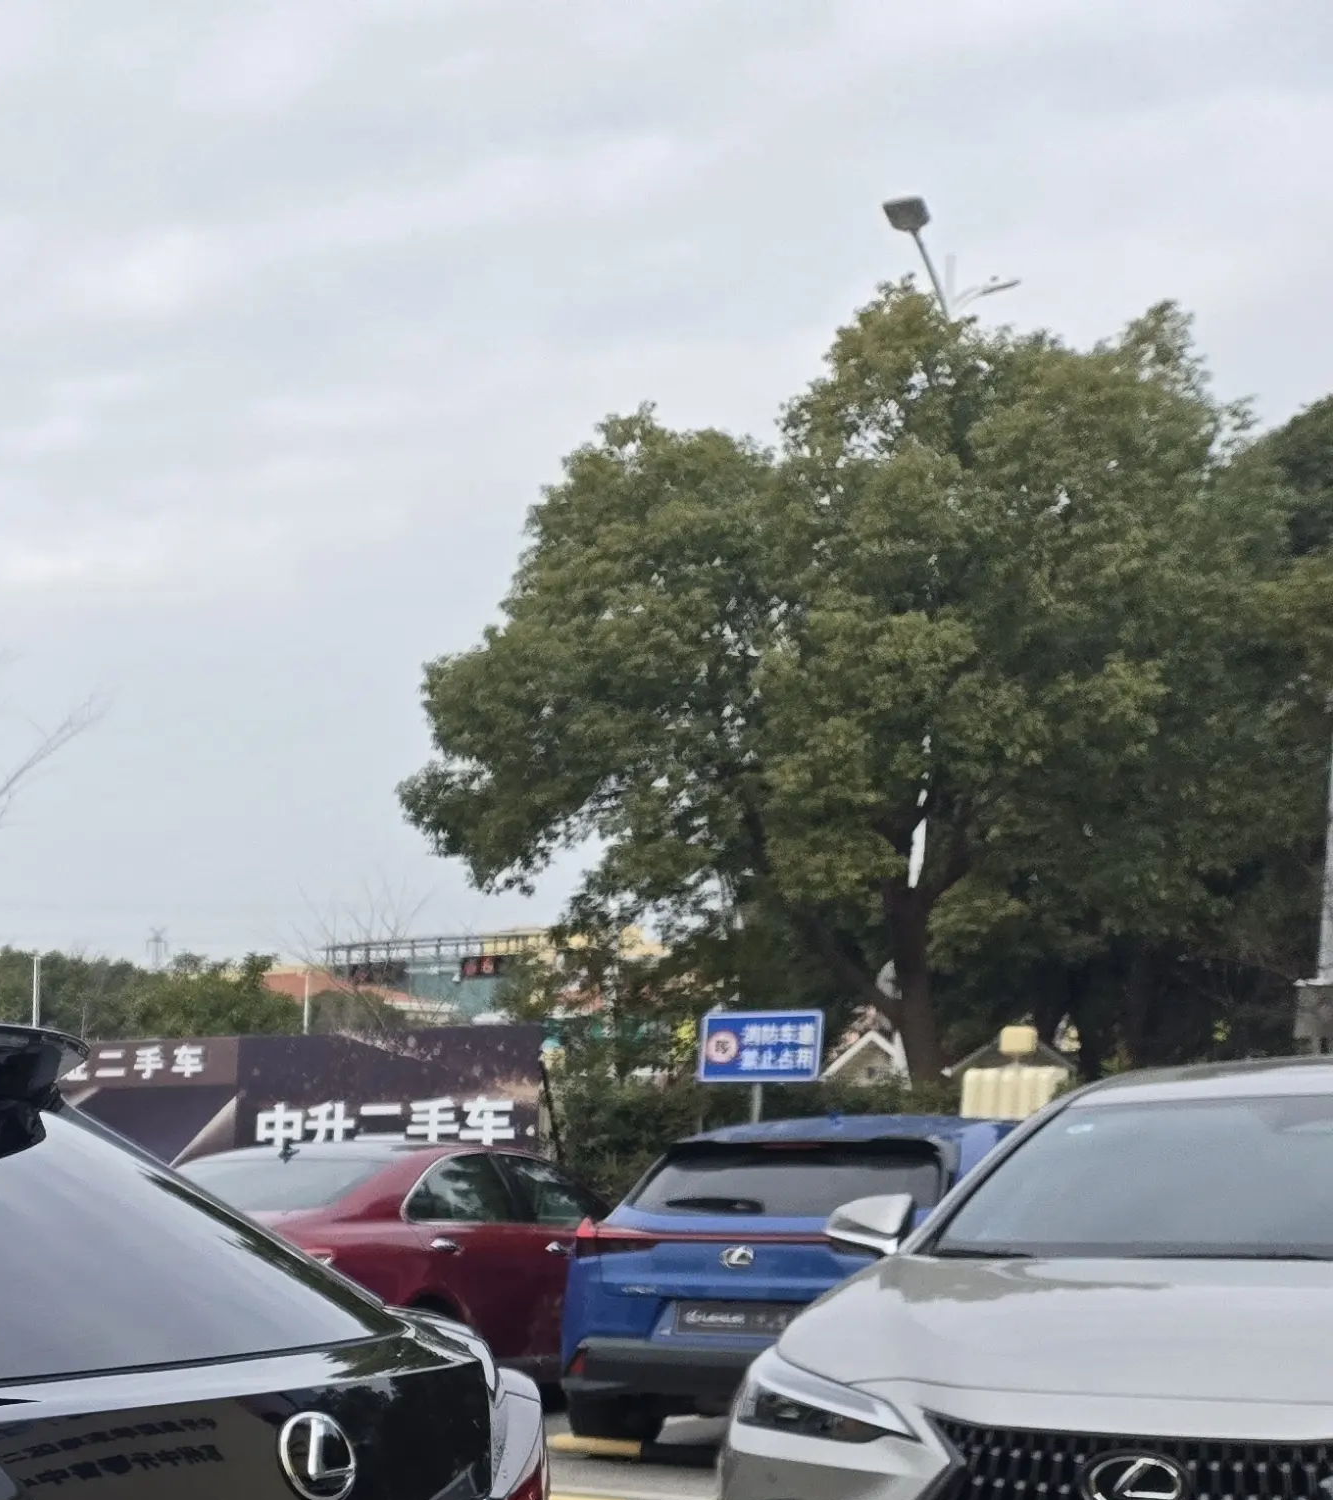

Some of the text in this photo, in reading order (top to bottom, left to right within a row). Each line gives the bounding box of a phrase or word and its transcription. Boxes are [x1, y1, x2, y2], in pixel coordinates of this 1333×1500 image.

[255, 1096, 515, 1147] 中升二手车
